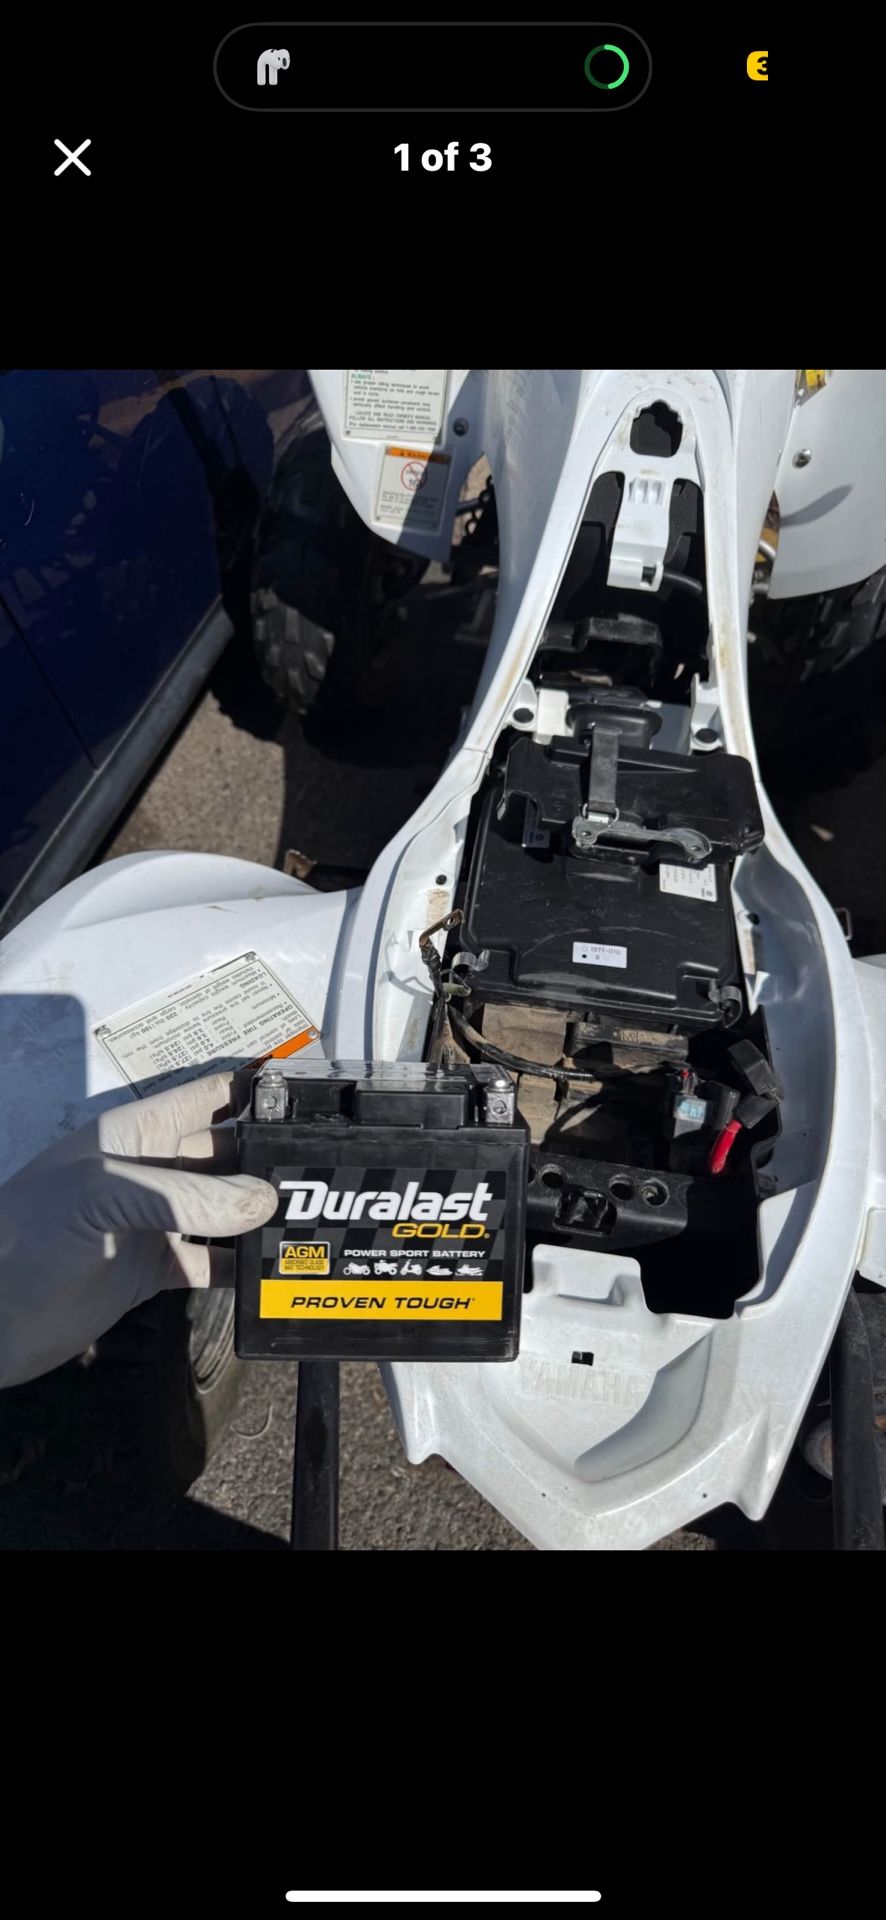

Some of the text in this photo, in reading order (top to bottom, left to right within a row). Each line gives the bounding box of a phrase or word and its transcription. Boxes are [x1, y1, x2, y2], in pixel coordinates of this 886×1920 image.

[239, 972, 267, 988] LOADING
[258, 1005, 294, 1026] OPERATING
[243, 1025, 257, 1035] TIRE
[206, 1035, 241, 1056] PRESSURE
[279, 1180, 493, 1221] Duralast
[284, 1246, 325, 1258] AGM
[344, 1249, 486, 1258] POWER SPORT BATTERY
[290, 1296, 471, 1310] PROVEN TOUGH
